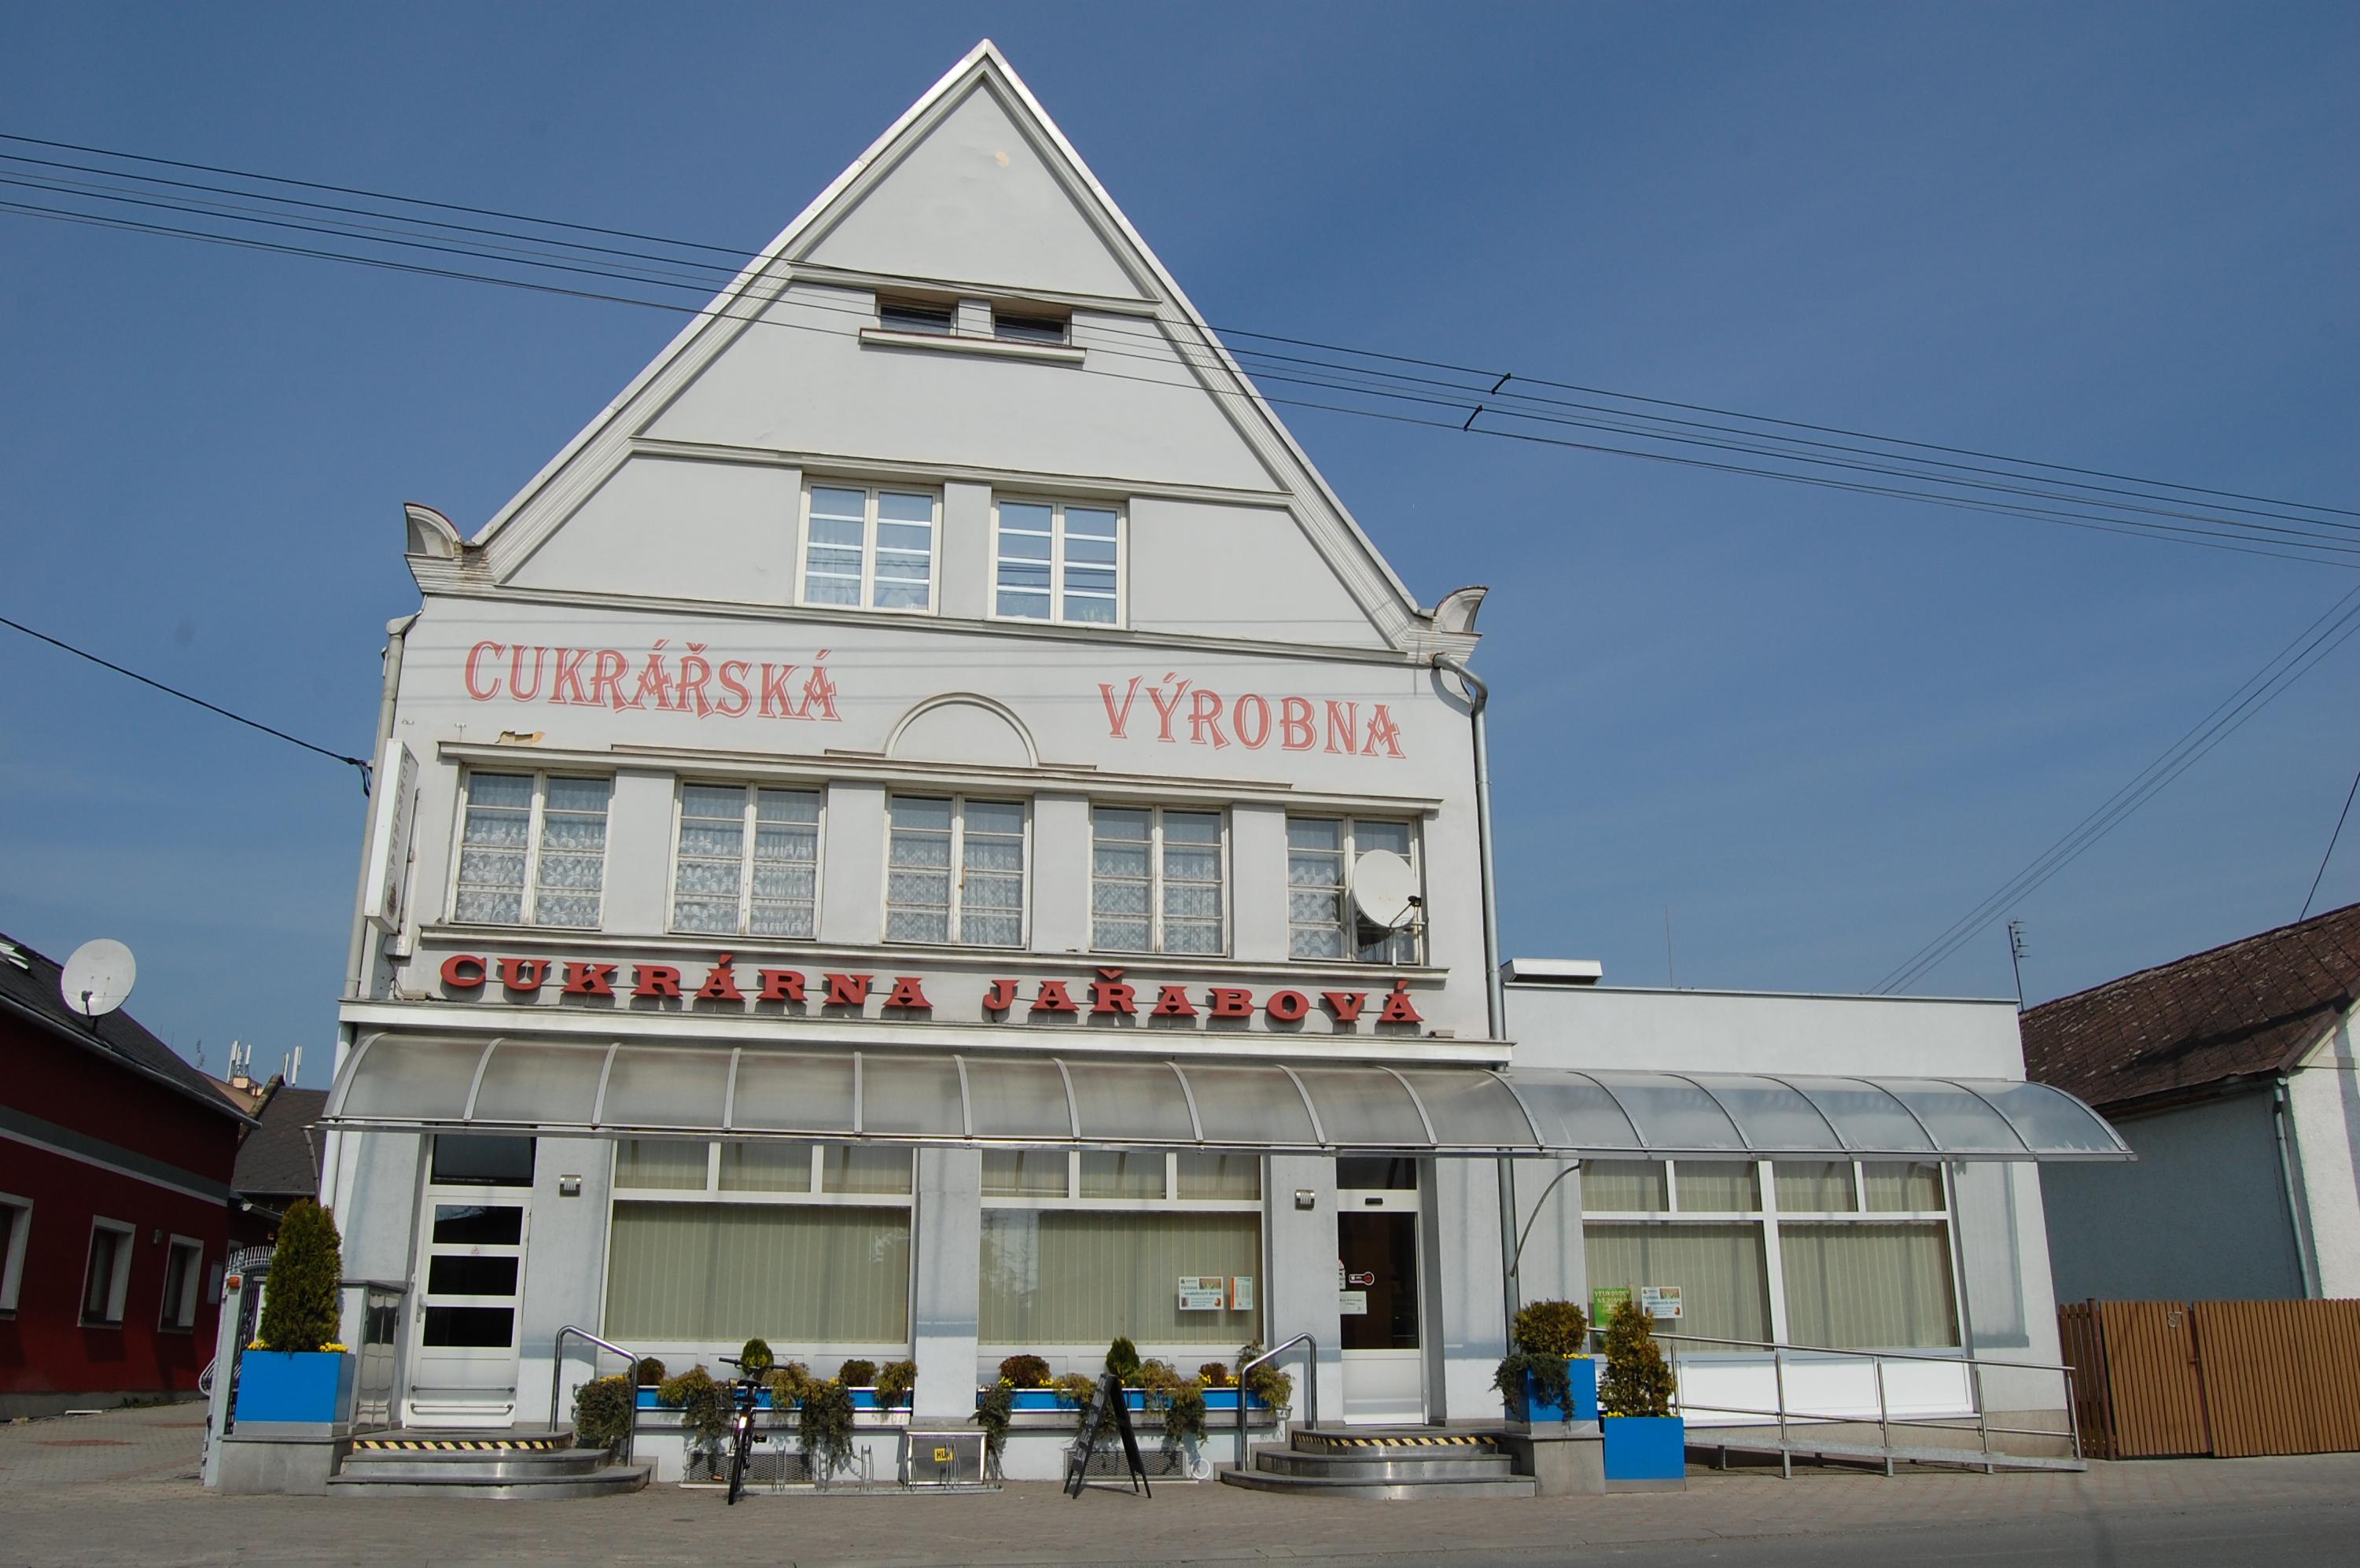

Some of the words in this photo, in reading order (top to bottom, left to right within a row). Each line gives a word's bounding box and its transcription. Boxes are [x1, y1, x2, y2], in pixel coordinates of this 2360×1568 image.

[465, 639, 842, 722] CUKRÁŘSKÁ
[1098, 672, 1406, 760] VÝROBNA
[440, 954, 933, 1009] CUKRÁRNA
[982, 968, 1424, 1021] JAŘABOVÁ
